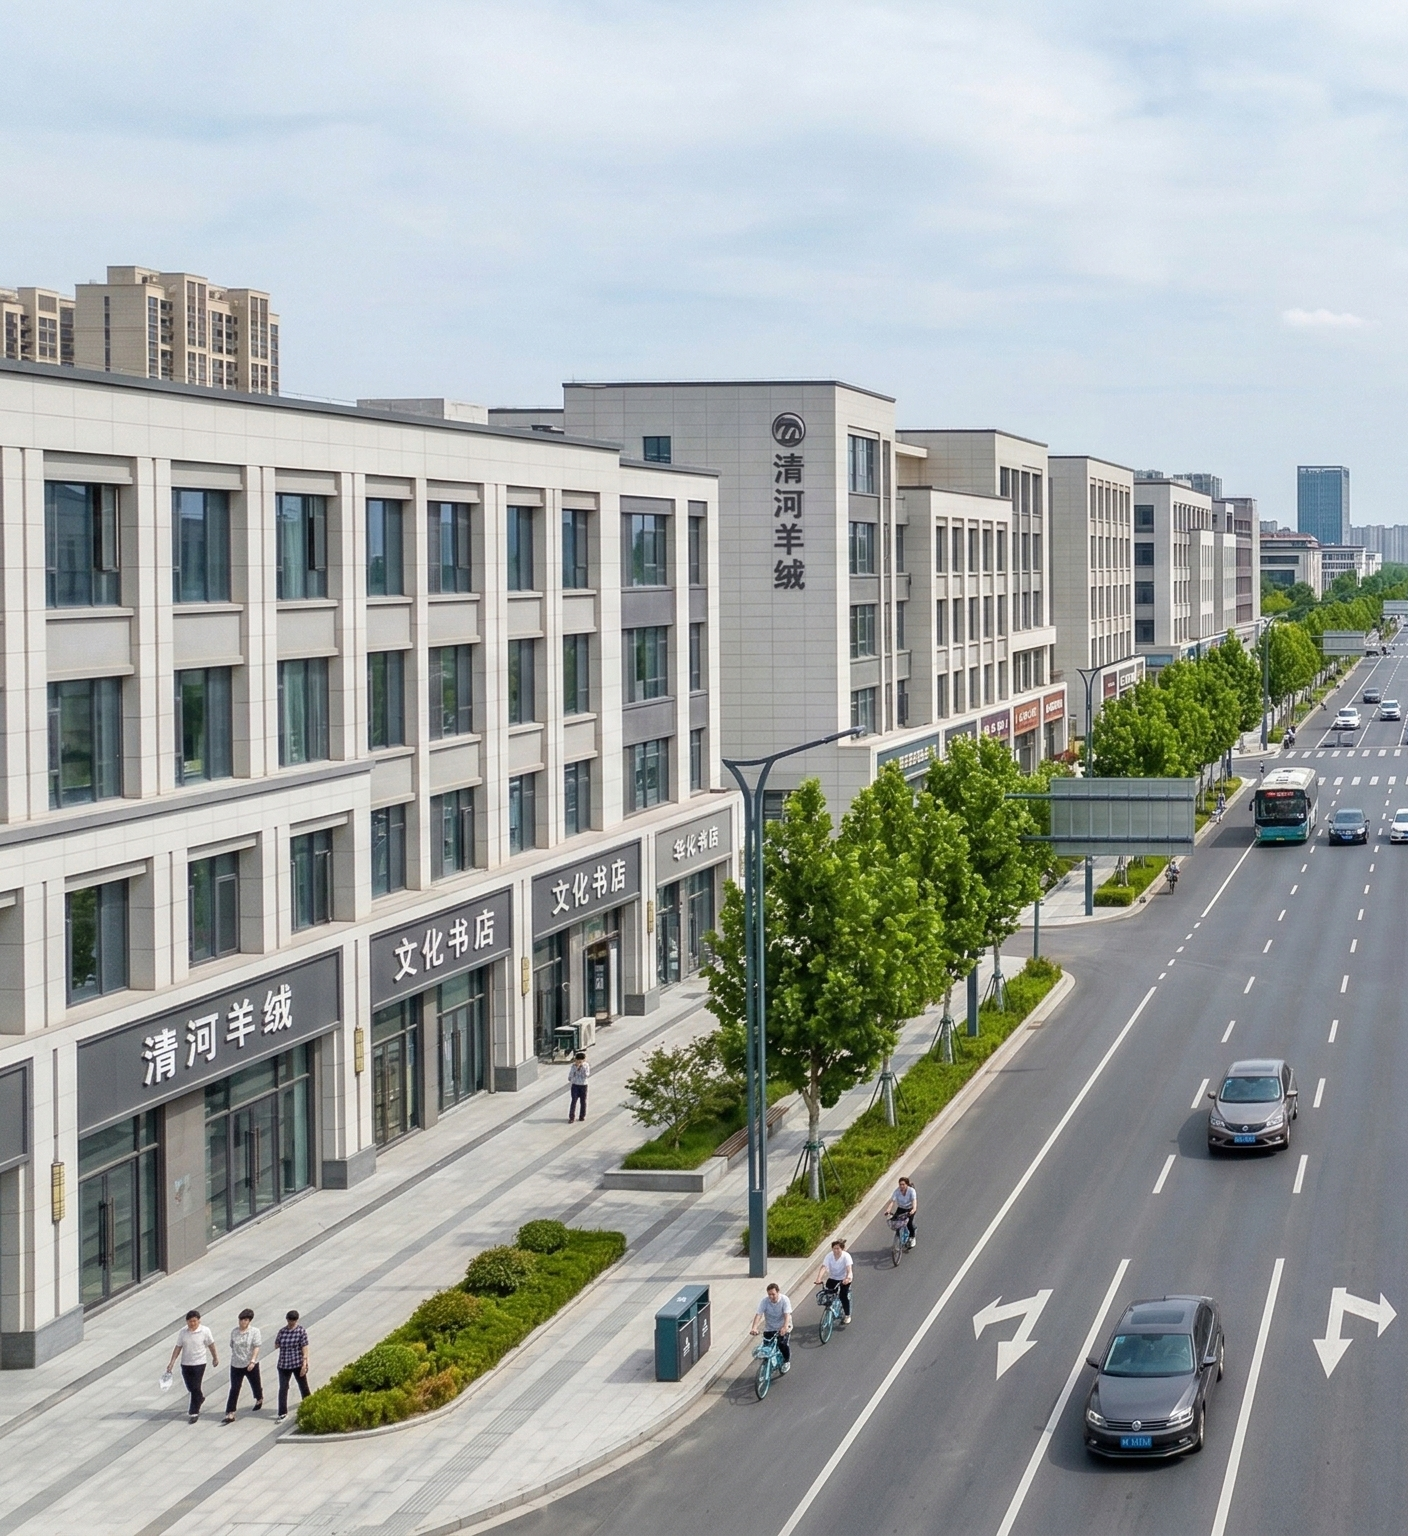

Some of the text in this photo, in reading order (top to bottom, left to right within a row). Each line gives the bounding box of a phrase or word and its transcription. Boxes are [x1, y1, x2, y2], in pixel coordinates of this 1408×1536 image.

[773, 453, 806, 590] 清河羊绒
[552, 858, 626, 916] 文化书店
[393, 908, 496, 982] 文化书店
[141, 983, 294, 1086] 清河羊绒
